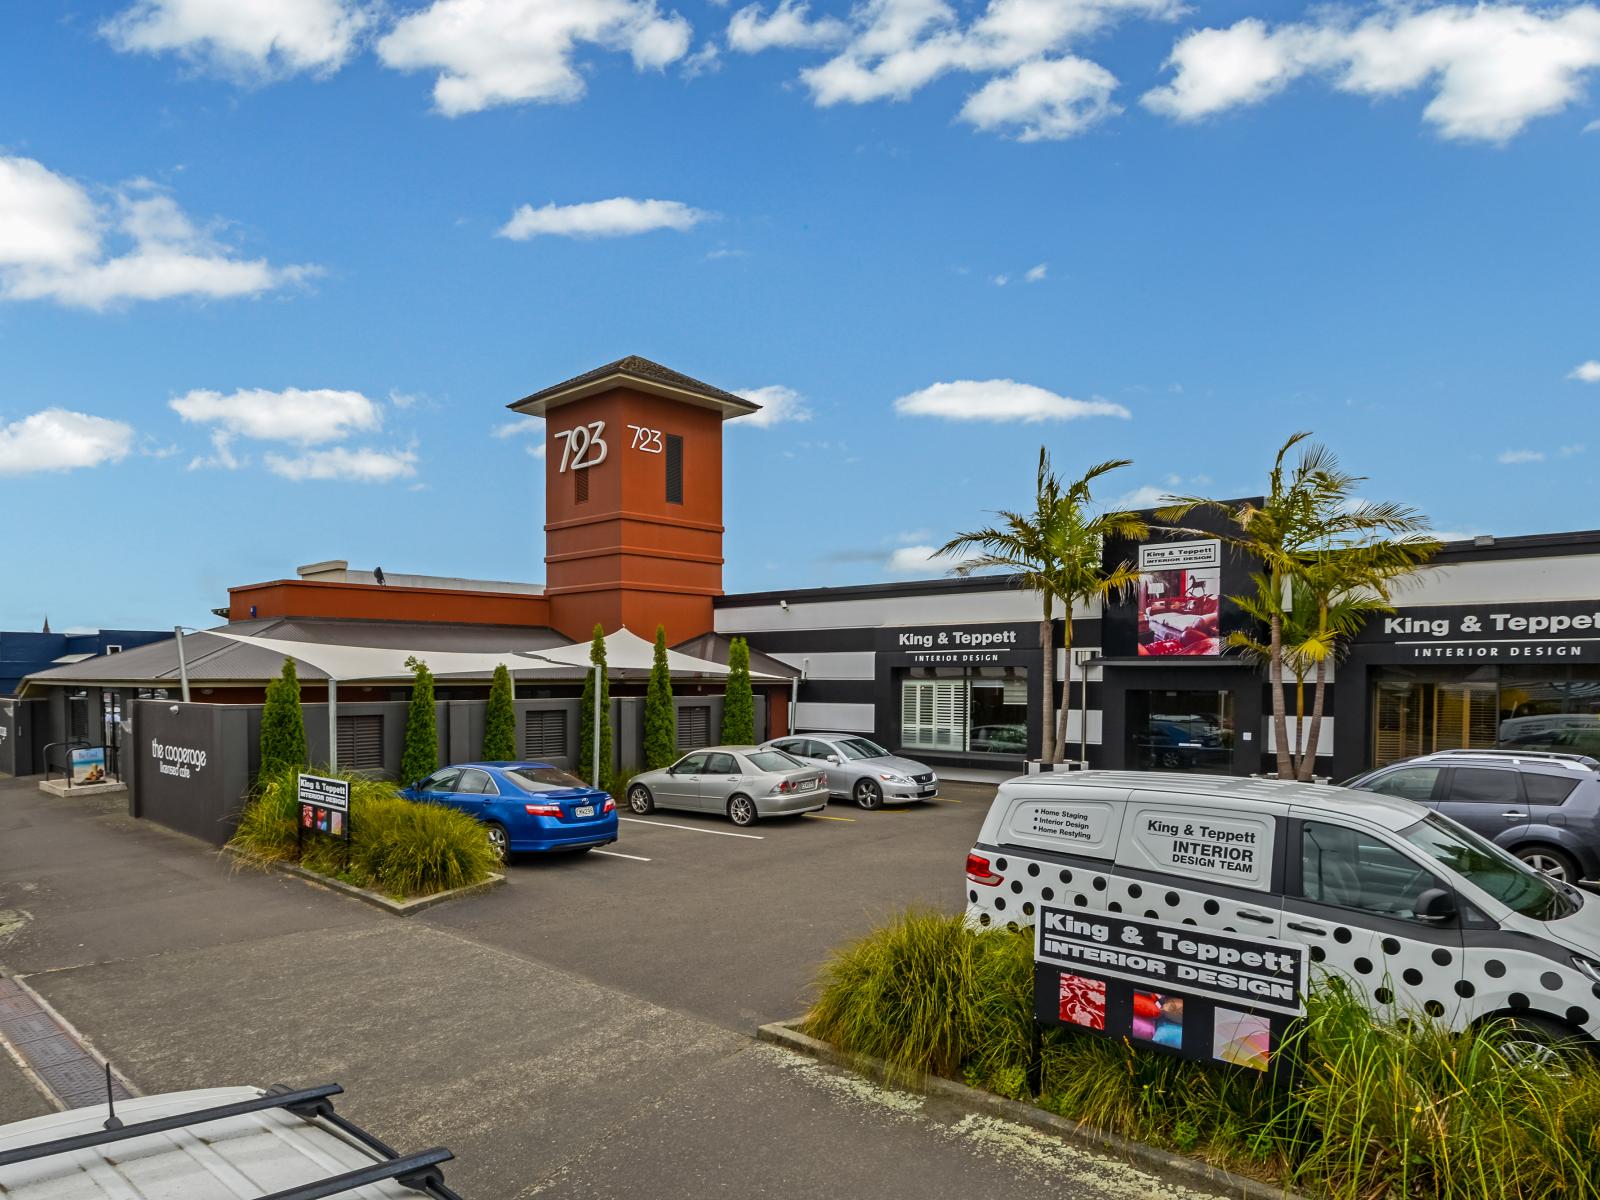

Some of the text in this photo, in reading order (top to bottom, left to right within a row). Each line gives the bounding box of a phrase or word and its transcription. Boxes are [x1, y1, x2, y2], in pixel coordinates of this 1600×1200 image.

[554, 420, 608, 473] 723
[627, 424, 663, 454] 723
[1178, 547, 1212, 555] Teppett
[1384, 617, 1449, 637] King
[1460, 615, 1482, 633] &
[899, 630, 1017, 648] King & Teppett
[962, 654, 998, 662] DESIGN
[1414, 646, 1581, 657] INTERIOR DESIGN
[151, 738, 207, 772] the cooperage
[300, 779, 346, 794] King & Teppett
[1039, 817, 1089, 830] Interior Design
[1040, 808, 1088, 821] Home Staging
[1038, 825, 1091, 840] Home Restyling
[1147, 819, 1256, 844] King & Teppett
[1173, 840, 1254, 863] INTERIOR
[1172, 853, 1253, 873] DESIGN TEAM
[1044, 911, 1294, 974] King & Teppett
[1044, 939, 1294, 1001] INTERIOR DESIGN
